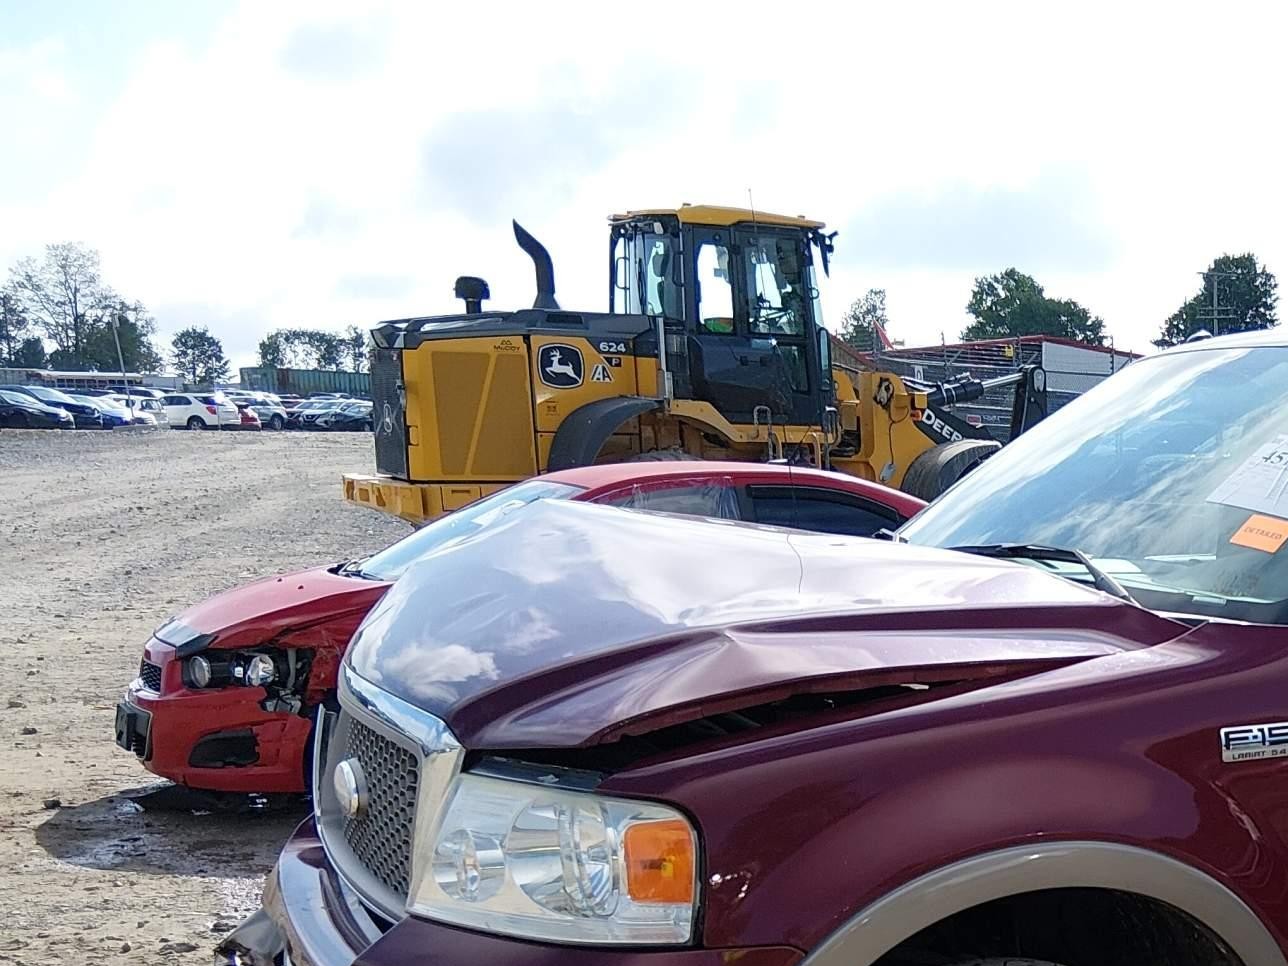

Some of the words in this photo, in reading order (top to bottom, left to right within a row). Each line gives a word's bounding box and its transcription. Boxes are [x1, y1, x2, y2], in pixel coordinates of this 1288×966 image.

[599, 341, 627, 353] 624
[611, 358, 621, 367] P
[921, 407, 966, 443] DEER
[1231, 749, 1267, 761] LARIAT
